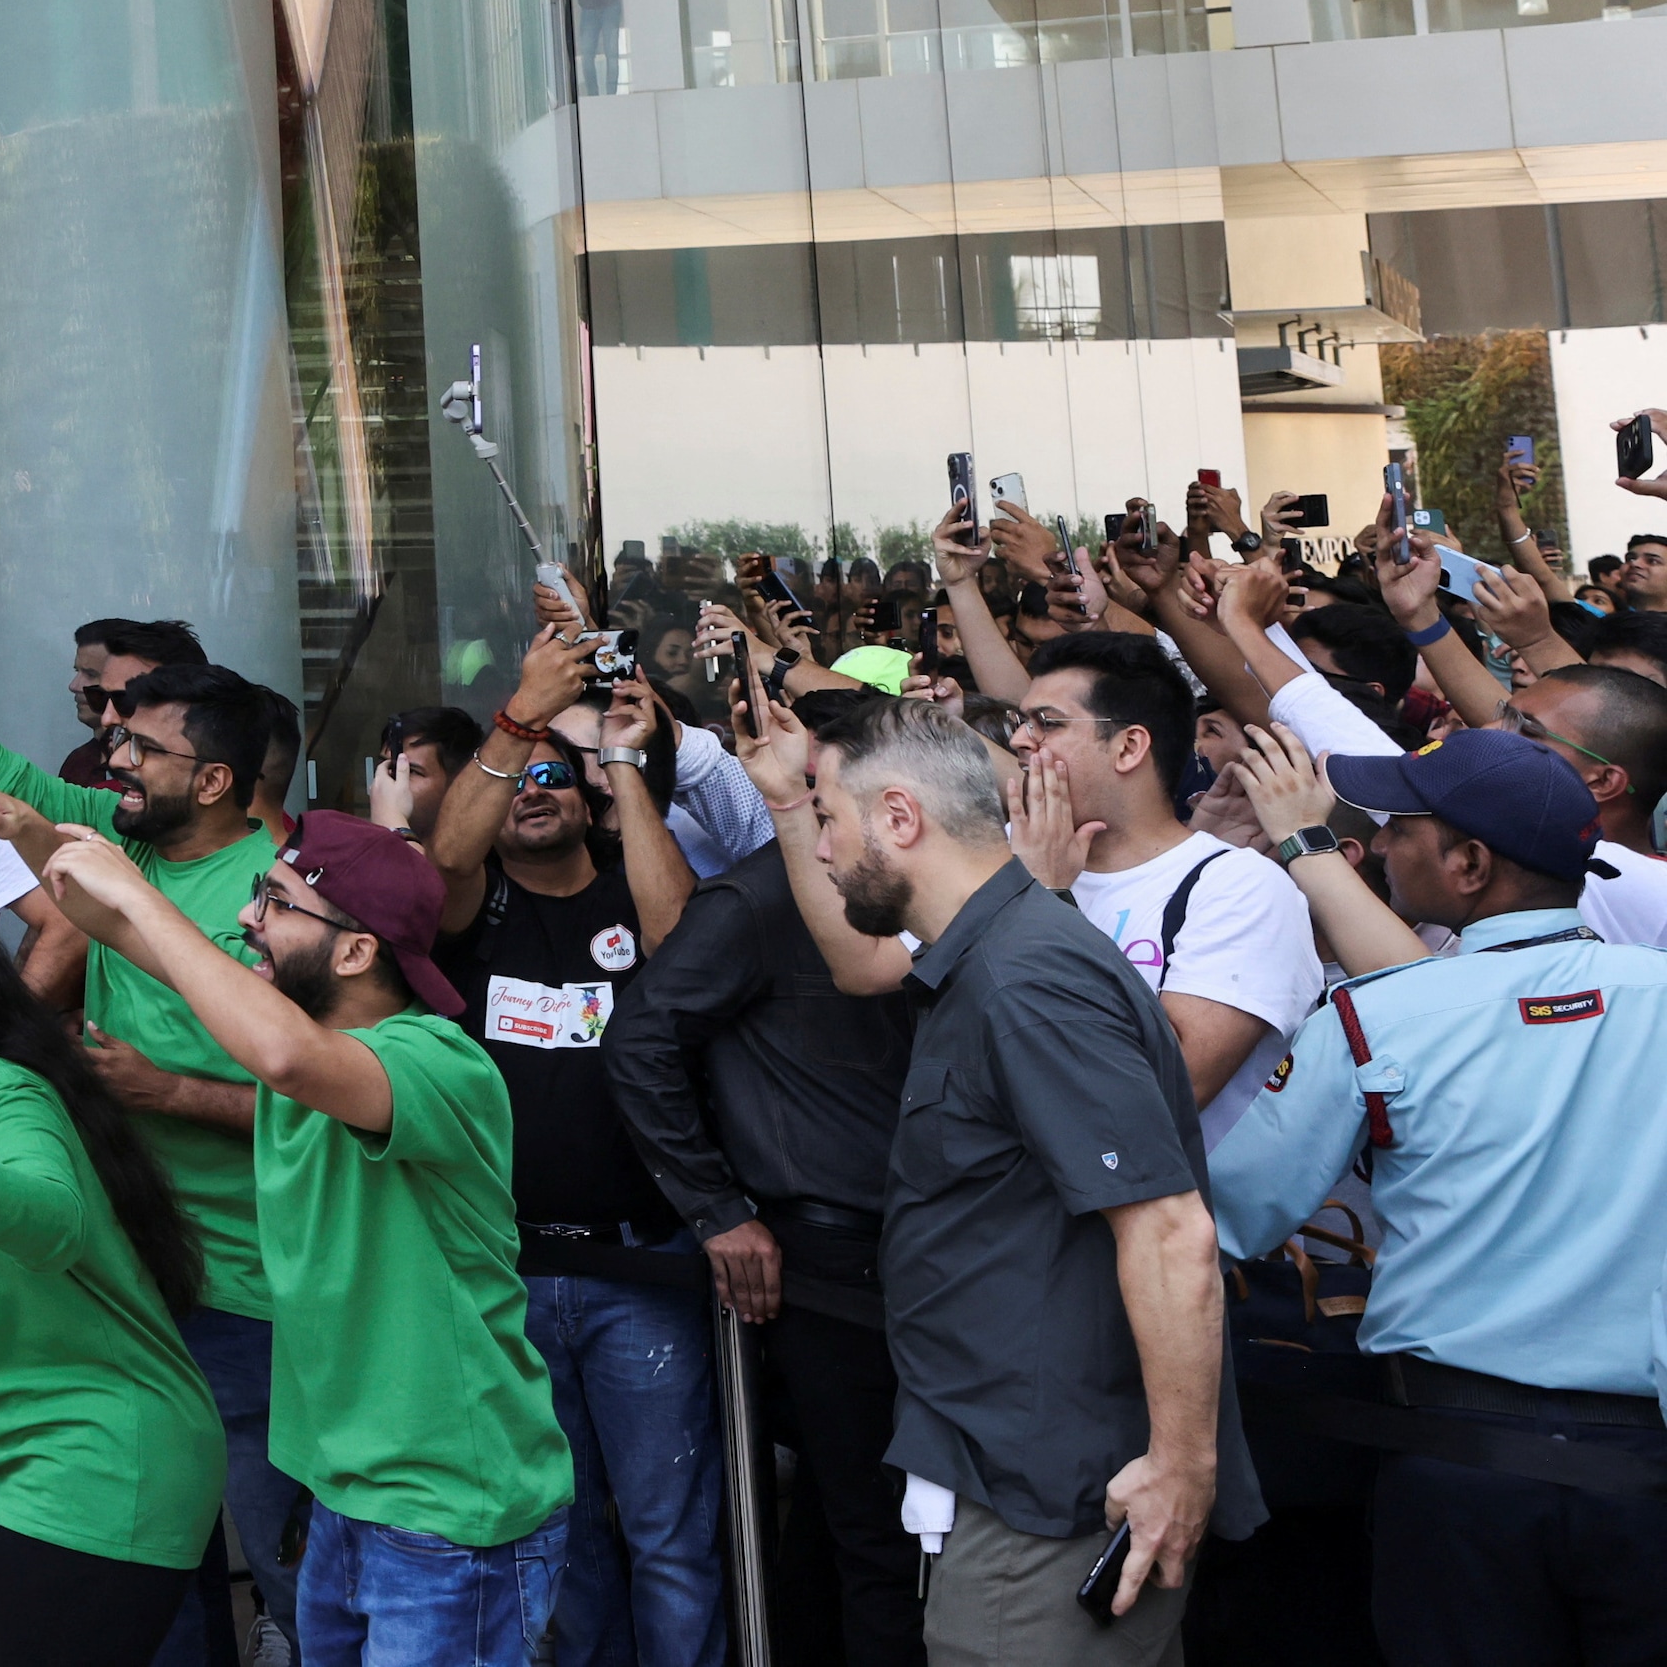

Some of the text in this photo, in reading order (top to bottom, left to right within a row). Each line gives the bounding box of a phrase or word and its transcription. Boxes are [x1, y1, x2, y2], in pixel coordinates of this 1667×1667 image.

[491, 986, 533, 1012] Journey
[1553, 999, 1594, 1013] SECURITY
[514, 1023, 548, 1035] SUBSCRIBE
